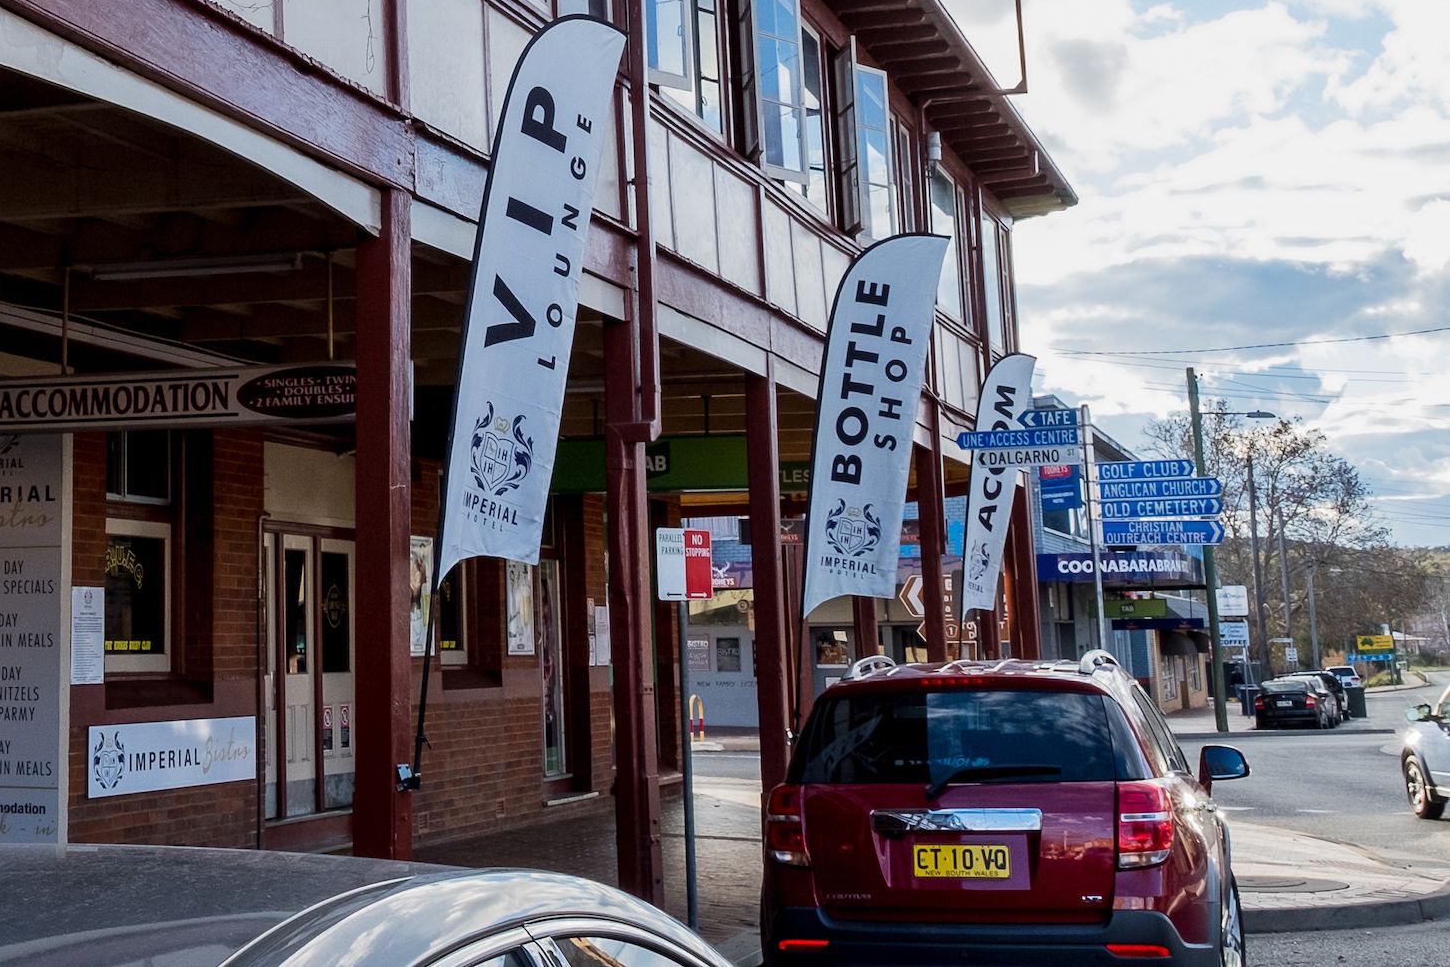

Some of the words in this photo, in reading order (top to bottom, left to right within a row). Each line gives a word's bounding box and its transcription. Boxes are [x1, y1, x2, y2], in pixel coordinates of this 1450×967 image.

[484, 86, 567, 348] VIP
[537, 114, 592, 370] LOUNGE
[265, 376, 314, 387] SINGLES
[831, 280, 890, 484] BOTTLE
[874, 326, 911, 451] SHOP
[284, 385, 342, 395] DOUBLES
[256, 398, 263, 407] 2
[266, 396, 312, 406] FAMILY
[317, 394, 357, 404] ENSUI
[1040, 410, 1070, 425] TAFE
[963, 433, 984, 447] UNE
[990, 431, 1029, 446] ACCESS
[1034, 429, 1075, 445] CENTRE
[646, 454, 667, 471] AB
[989, 449, 1060, 465] DALGARNO
[1102, 464, 1136, 478] GOLF
[1143, 461, 1179, 476] CLUB
[1104, 483, 1157, 497] ANGLICAN
[1162, 481, 1207, 495] CHURCH
[462, 490, 518, 526] IMPERIAL
[1104, 502, 1130, 517] OLD
[1137, 500, 1207, 515] CEMETERY
[1129, 521, 1183, 532] CHRISTIAN
[692, 534, 703, 545] NO
[1106, 532, 1161, 543] OUTREACH
[1166, 532, 1207, 543] CENTRE
[686, 547, 710, 557] STOPPING
[4, 561, 24, 574] DAY
[821, 556, 877, 574] IMPERIAL
[4, 579, 54, 594] SPECIALS
[18, 634, 53, 647] MEALS
[129, 747, 201, 772] IMPERIAL
[203, 726, 250, 774] Bistro
[16, 761, 52, 776] MEALS
